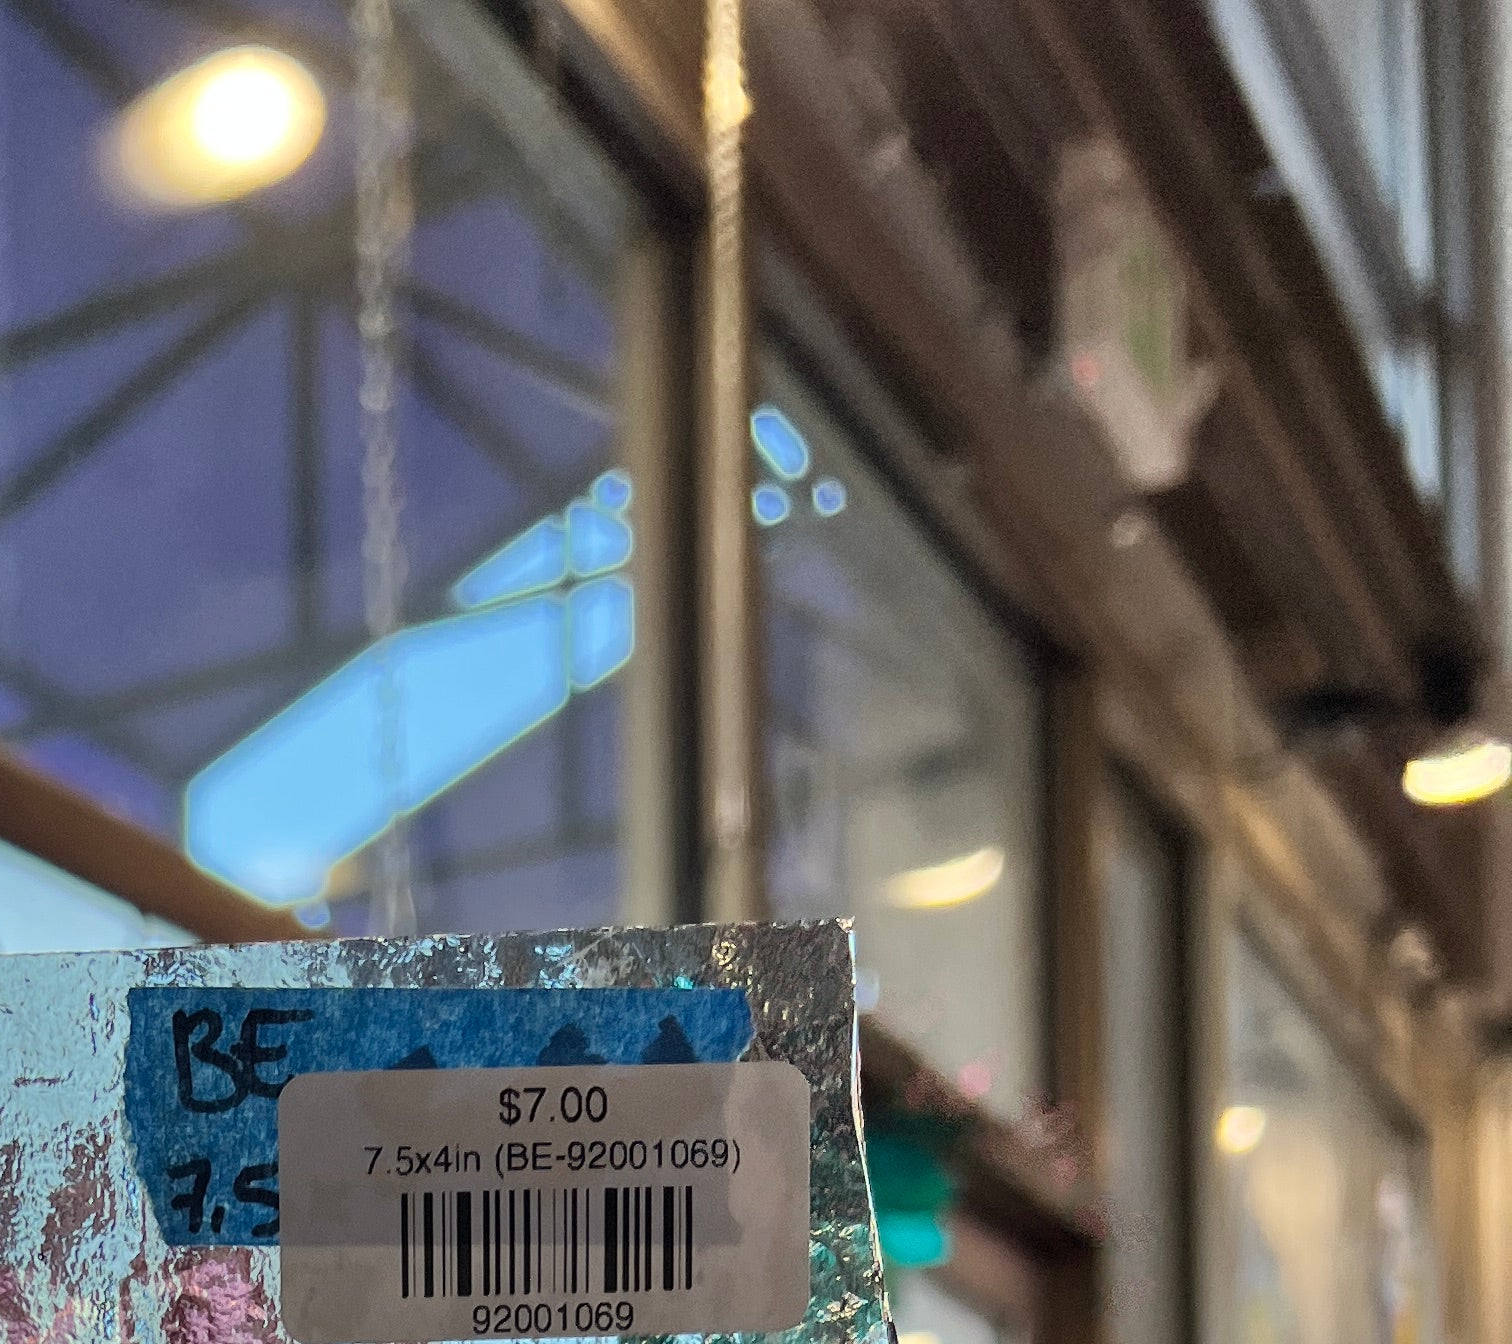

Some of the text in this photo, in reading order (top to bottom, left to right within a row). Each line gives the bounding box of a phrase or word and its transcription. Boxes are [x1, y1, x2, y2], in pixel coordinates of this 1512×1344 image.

[171, 1007, 315, 1114] BE
[498, 1085, 609, 1127] $7.00
[363, 1138, 742, 1181] 7.5x4in (BE-92001069)
[471, 1300, 635, 1336] 92001069
